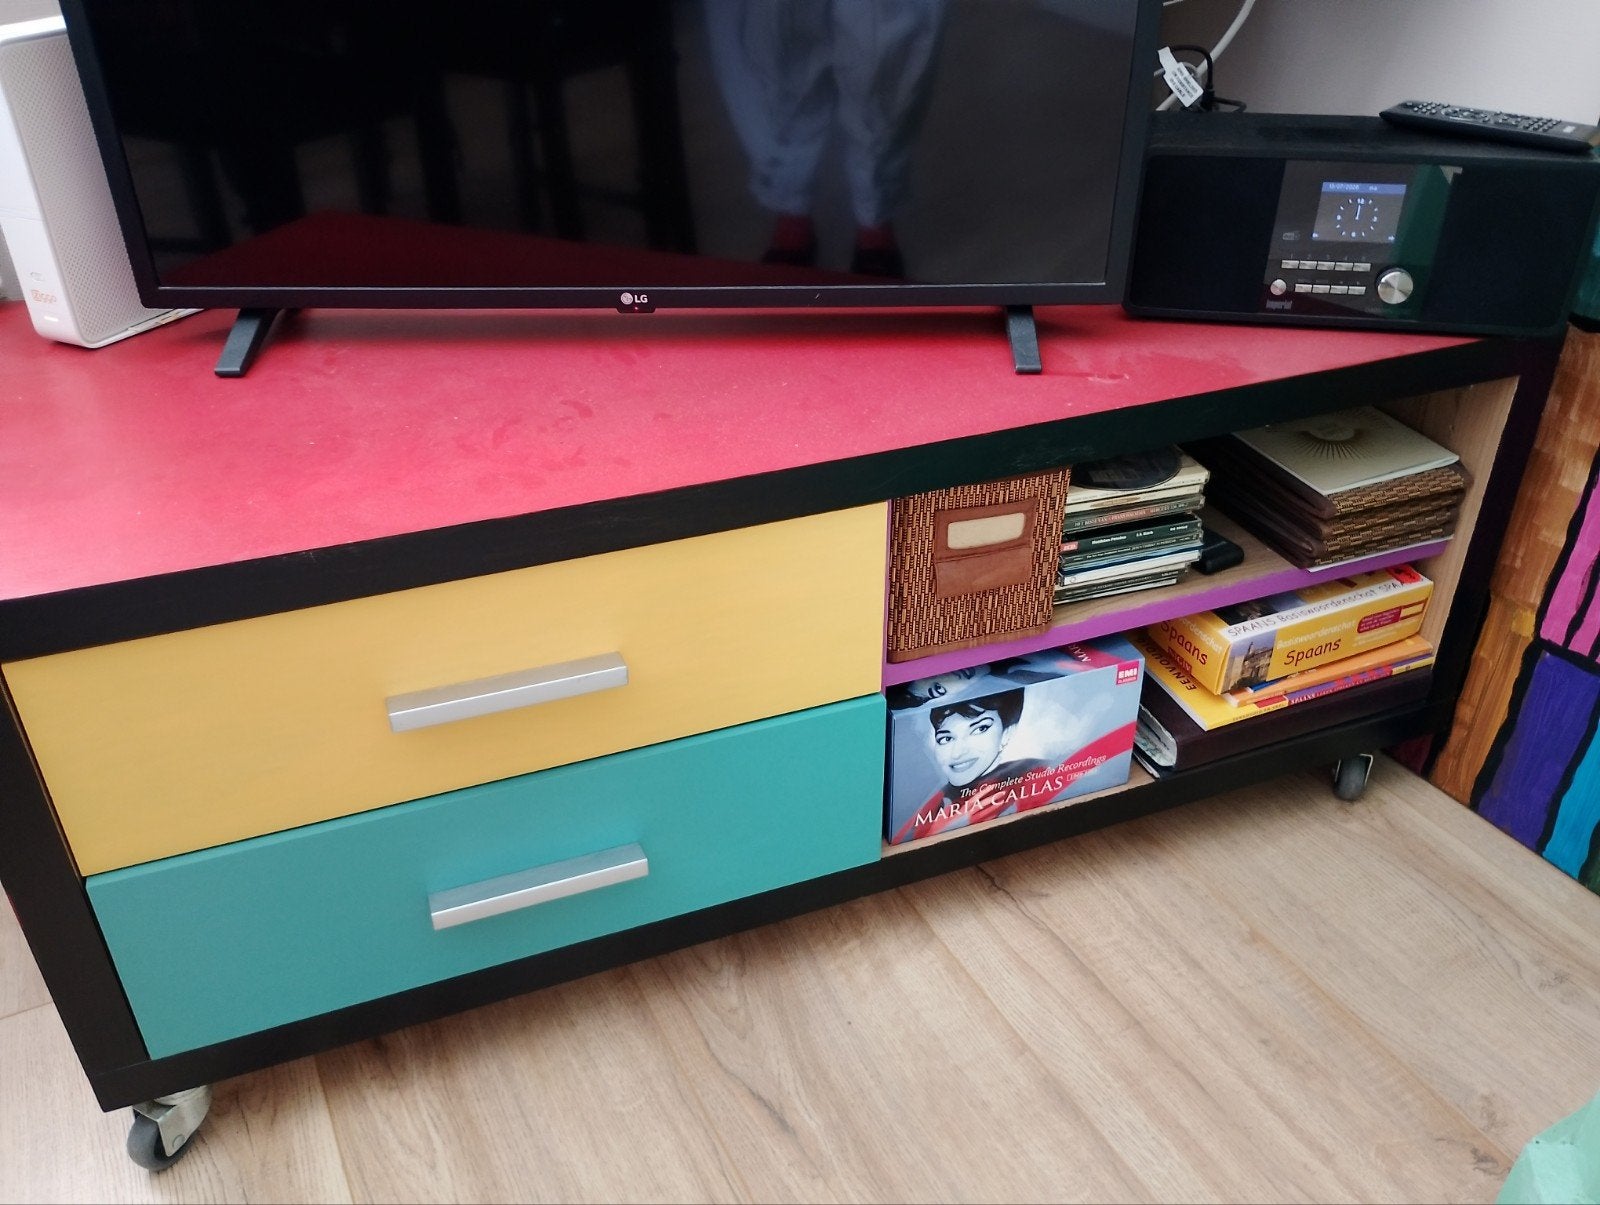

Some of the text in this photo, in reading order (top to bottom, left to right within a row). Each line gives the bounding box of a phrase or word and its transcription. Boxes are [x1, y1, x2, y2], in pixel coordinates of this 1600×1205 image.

[634, 294, 649, 304] LG
[1283, 638, 1342, 667] Spaans
[1118, 667, 1138, 679] EMI
[960, 787, 977, 798] The
[979, 777, 1023, 793] Complete
[1024, 766, 1056, 782] Studio
[1057, 754, 1107, 774] Recordings
[914, 798, 984, 827] MARIA
[990, 775, 1064, 807] CALLAS
